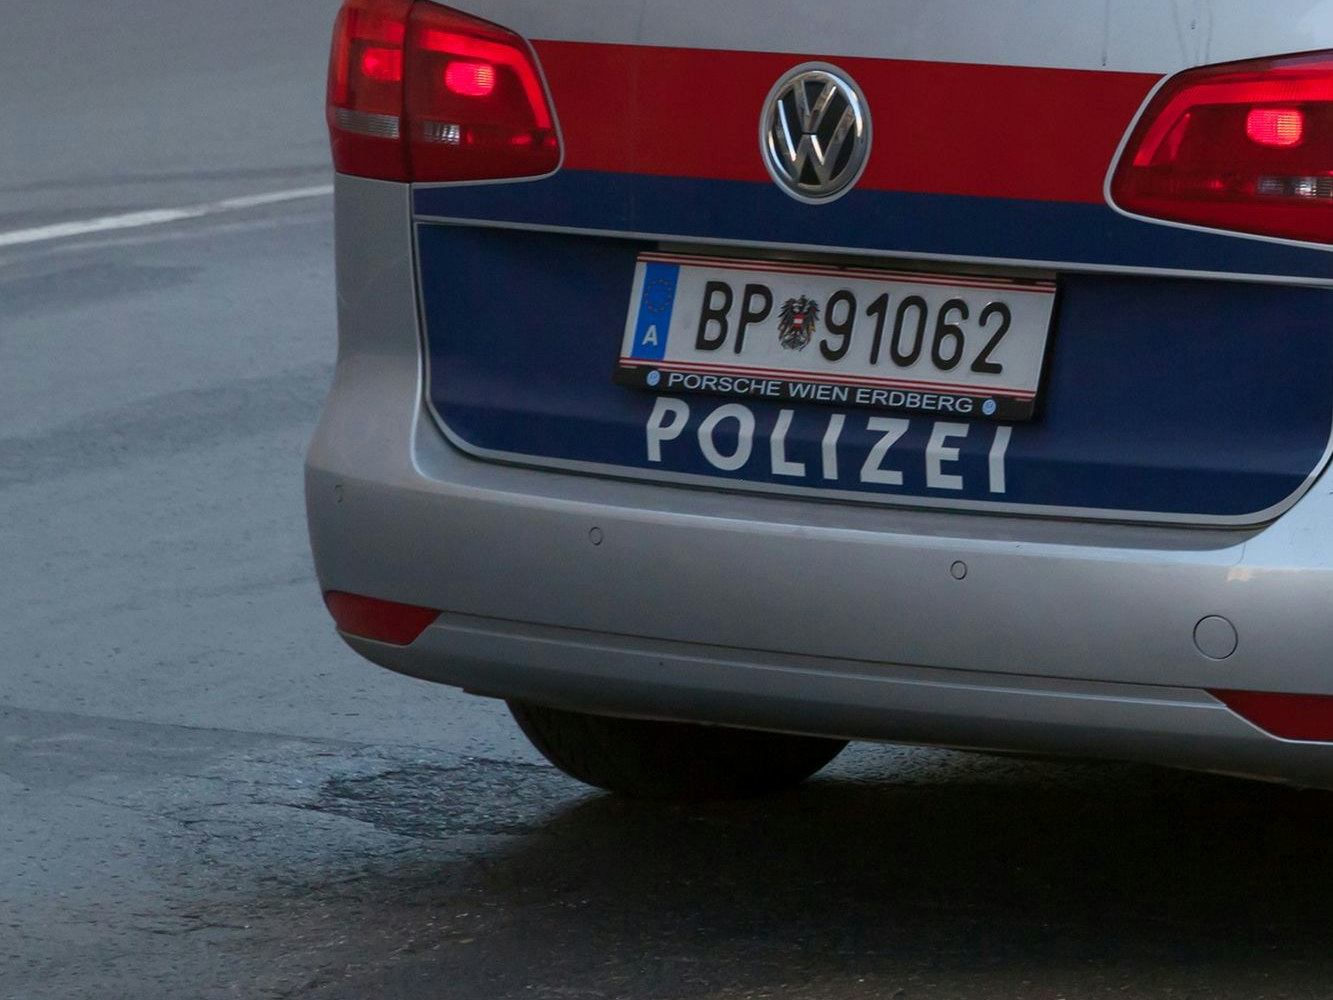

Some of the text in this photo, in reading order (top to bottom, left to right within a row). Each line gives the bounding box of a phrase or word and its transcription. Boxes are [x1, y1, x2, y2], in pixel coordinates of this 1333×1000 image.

[641, 324, 659, 347] A
[694, 280, 1013, 374] BP 91062
[667, 373, 974, 413] PORSCHE WIEN ERDBERG
[646, 396, 1012, 493] POLIZEI
